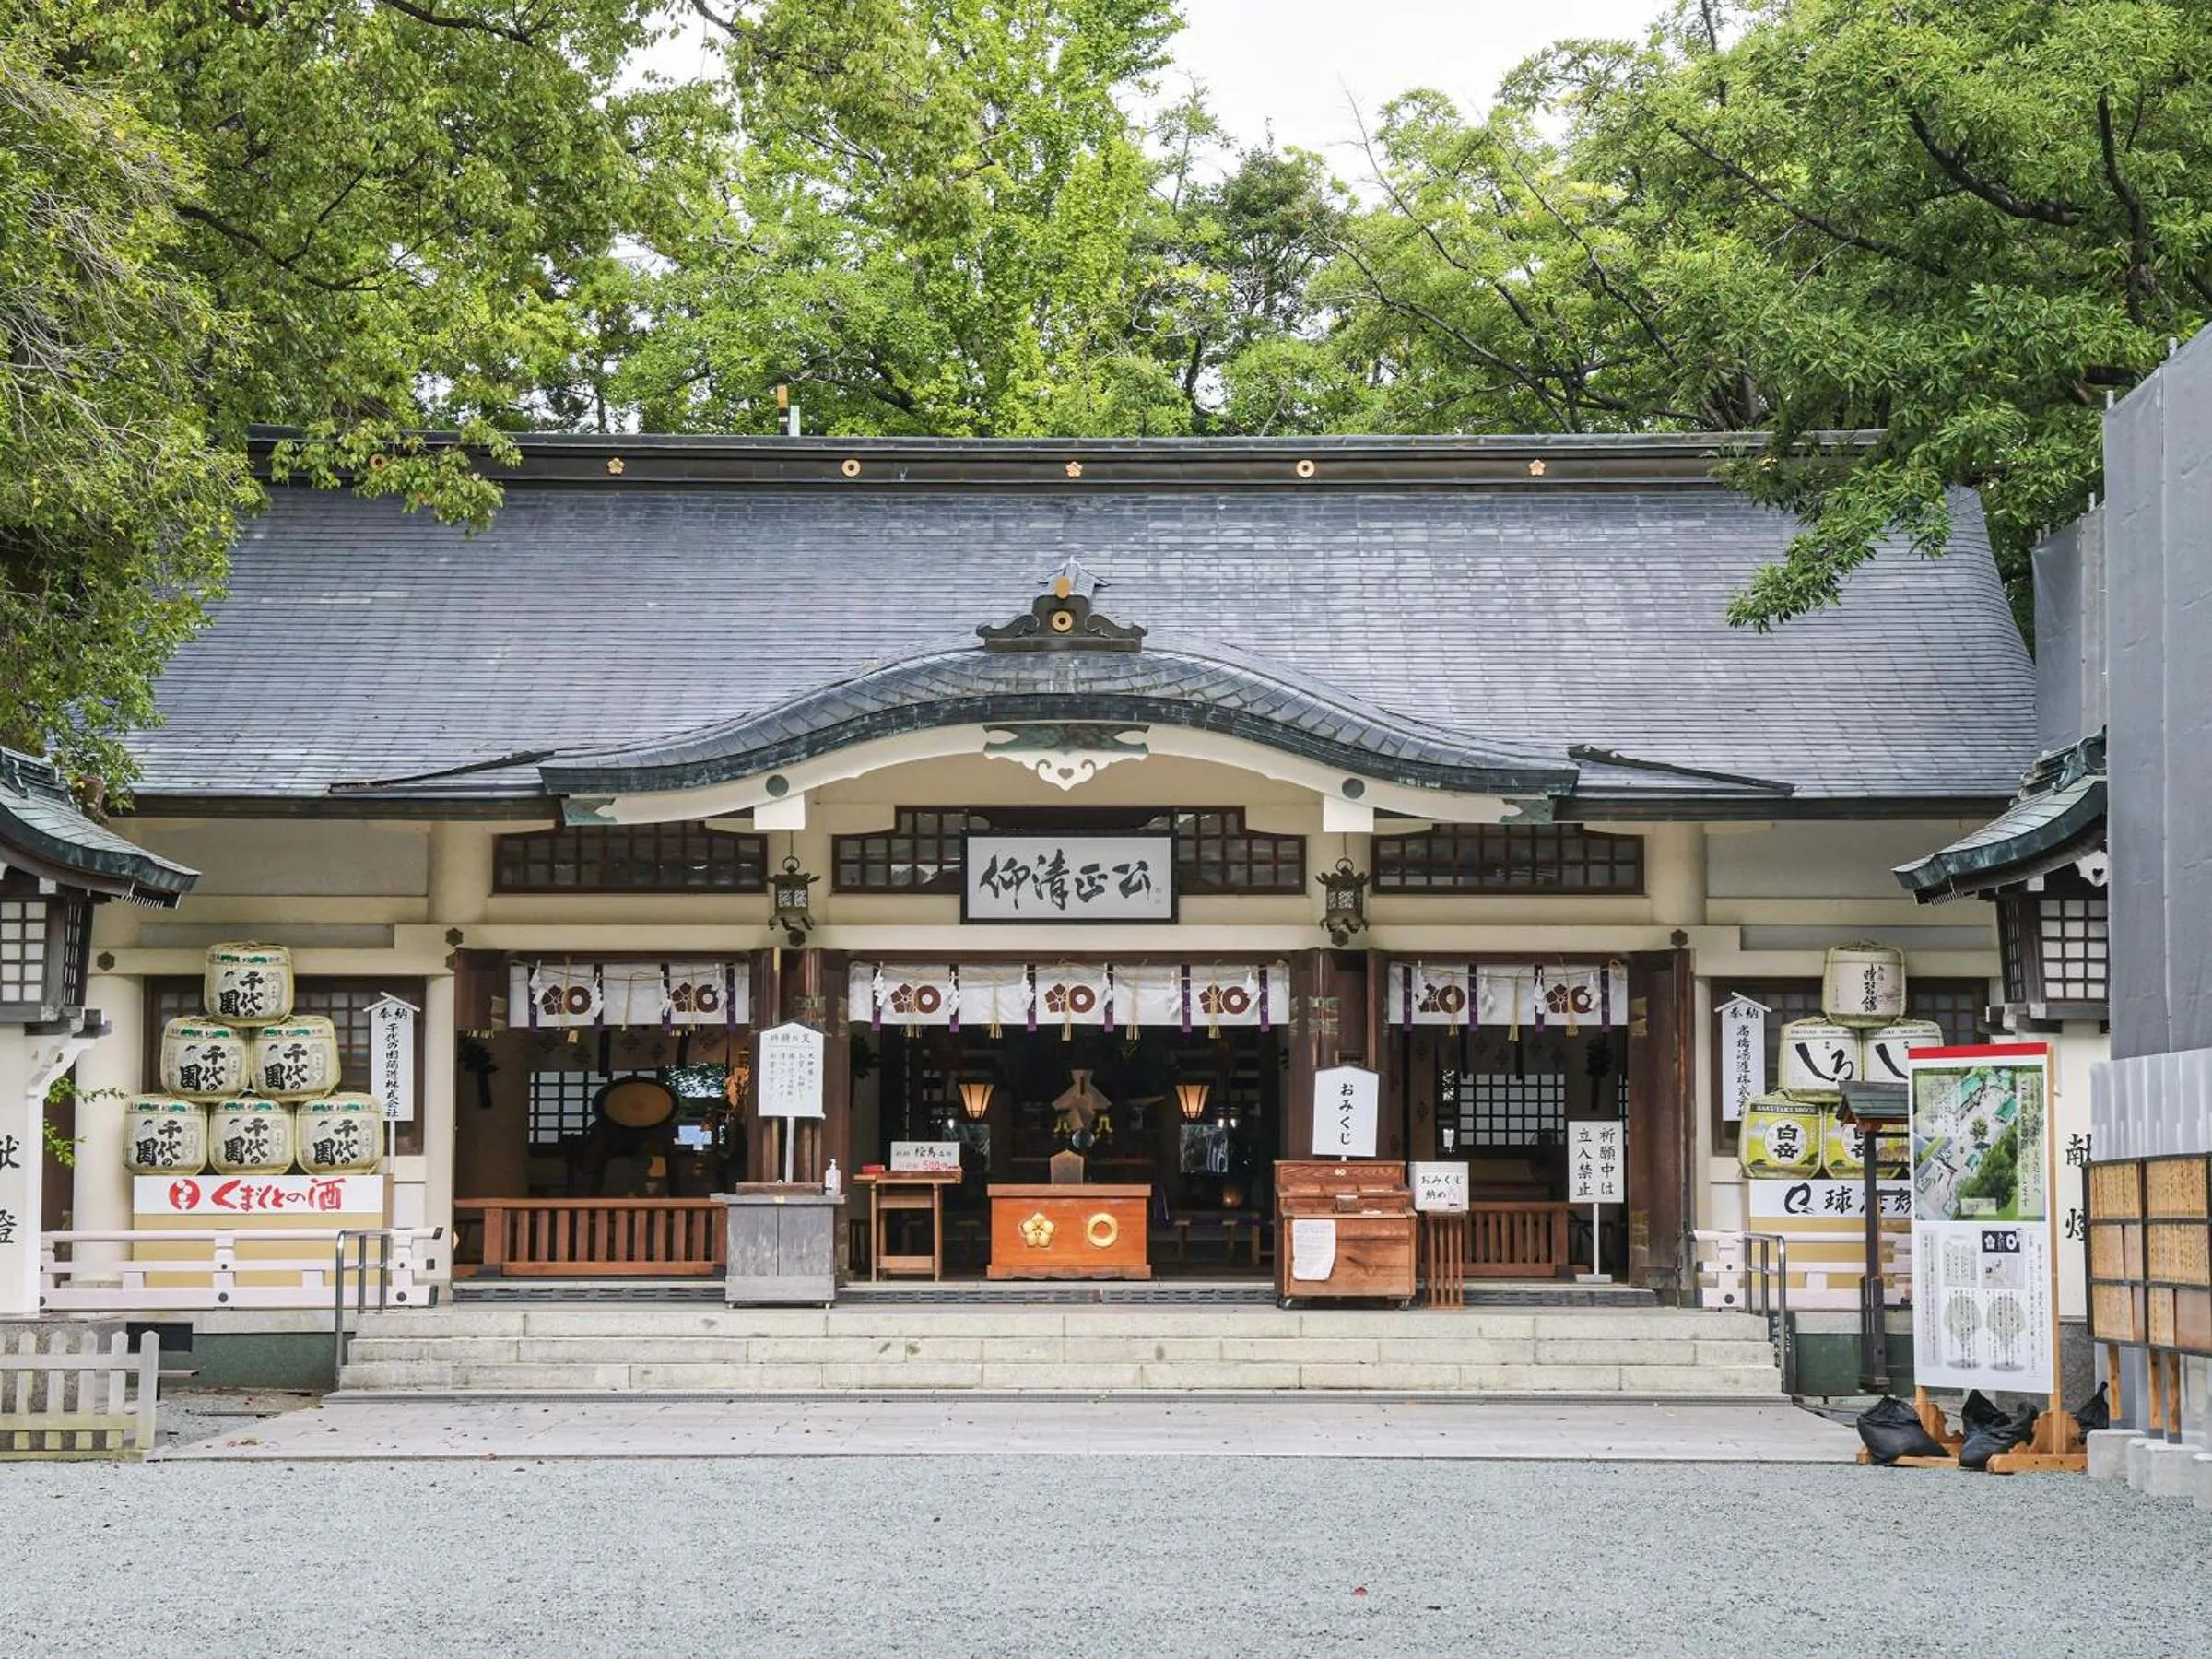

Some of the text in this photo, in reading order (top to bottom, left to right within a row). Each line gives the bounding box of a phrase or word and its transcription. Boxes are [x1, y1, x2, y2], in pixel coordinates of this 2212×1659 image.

[378, 1007, 407, 1020] 奉納
[1732, 1006, 1759, 1019] 奉納
[1795, 1042, 1854, 1082] しろ
[1875, 1042, 1909, 1080] し
[1338, 1083, 1354, 1145] おみくじ
[1773, 1124, 1798, 1159] 白岳
[1421, 1175, 1463, 1184] おみくじ
[1576, 1127, 1593, 1196] 立入禁止
[1599, 1127, 1616, 1195] 祈願中は
